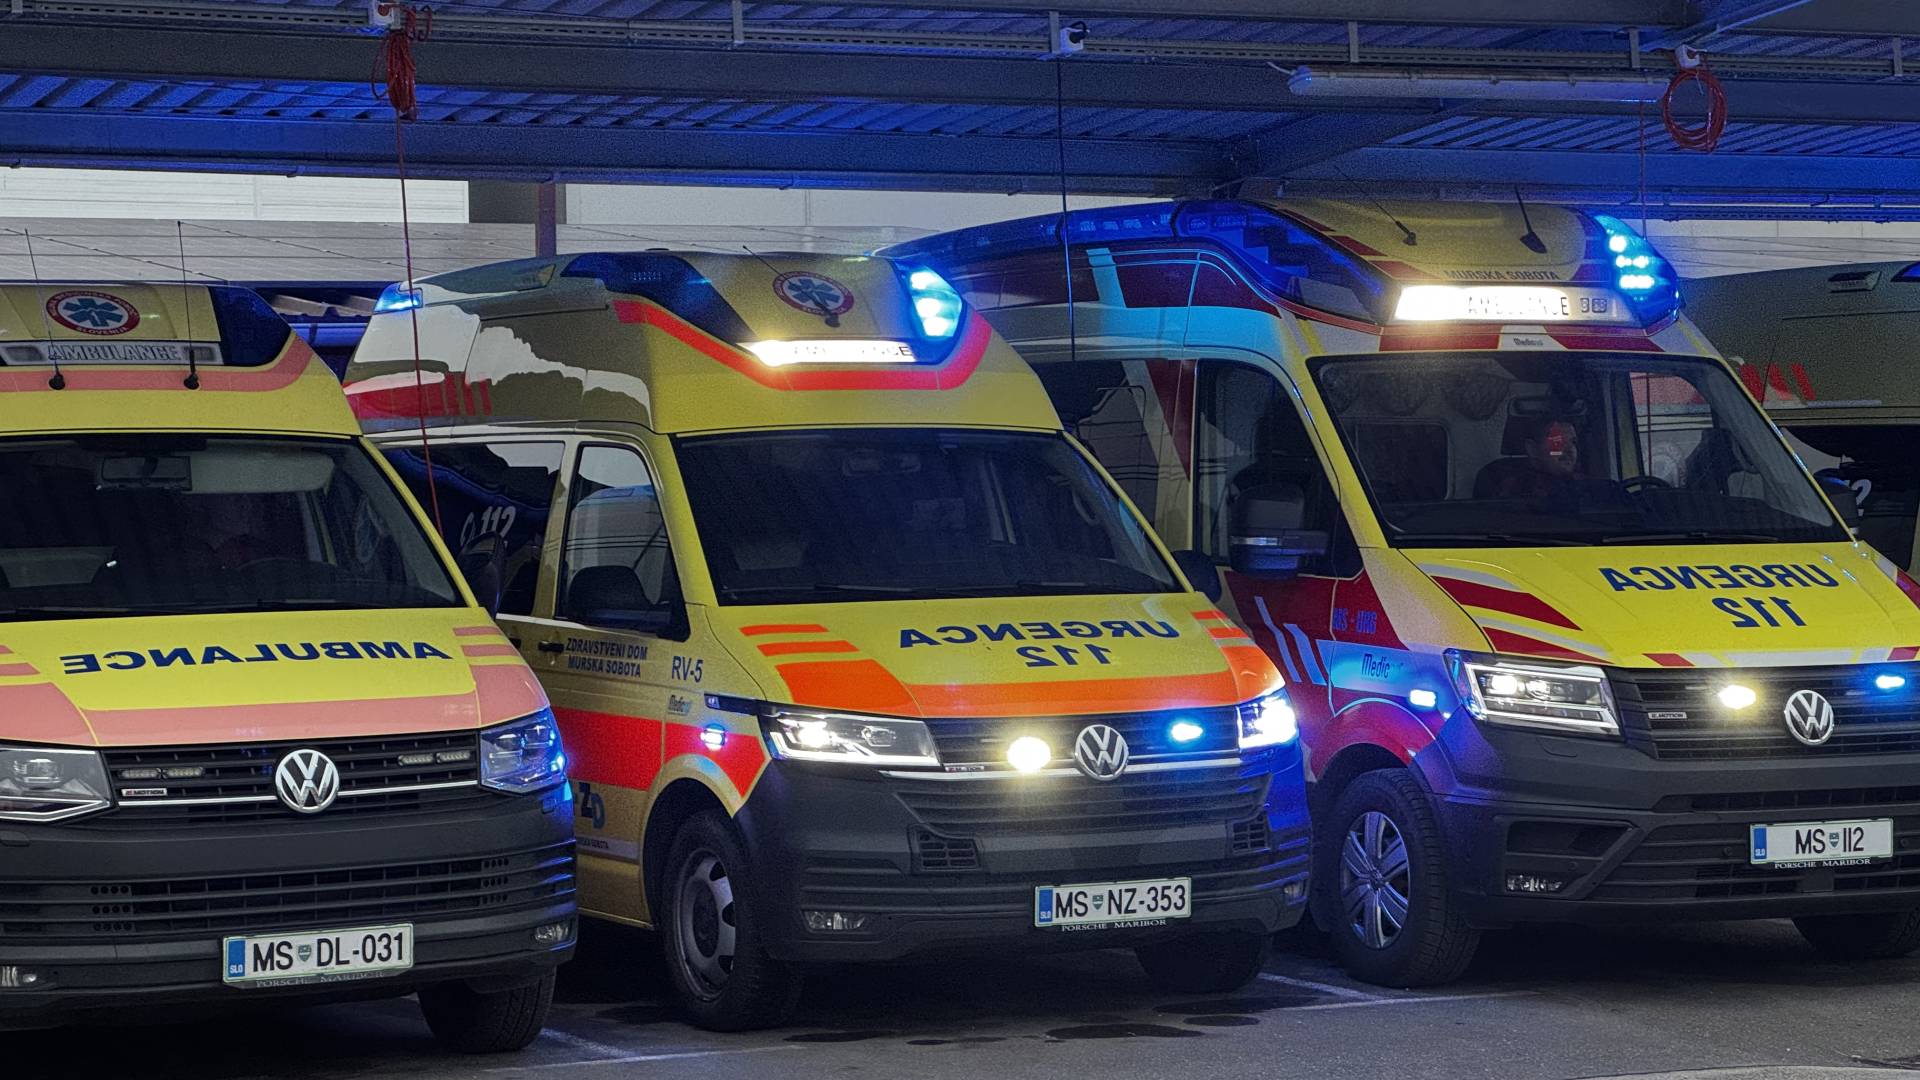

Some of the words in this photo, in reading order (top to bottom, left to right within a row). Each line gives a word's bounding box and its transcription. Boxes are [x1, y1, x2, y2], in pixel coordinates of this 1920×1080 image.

[1509, 270, 1560, 280] SOBOTA
[48, 345, 182, 360] AMBULANCE
[566, 638, 626, 658] ZDRAVSTVENI
[627, 645, 648, 660] DOM
[568, 656, 604, 673] MURSKA
[606, 661, 642, 678] SOBOTA
[671, 655, 704, 683] RV-5
[1795, 828, 1826, 855] MS
[1774, 861, 1816, 869] PORSCHE
[1822, 858, 1872, 867] MARIBOR
[1055, 891, 1089, 919] MS
[1107, 884, 1186, 915] NZ-353
[1061, 923, 1108, 932] PORSCHE
[1114, 919, 1167, 929] MARIBOR
[253, 941, 293, 973] MS
[316, 932, 404, 967] DL-031
[256, 977, 312, 988] PORSCHE
[320, 971, 385, 983] MARIBOR
